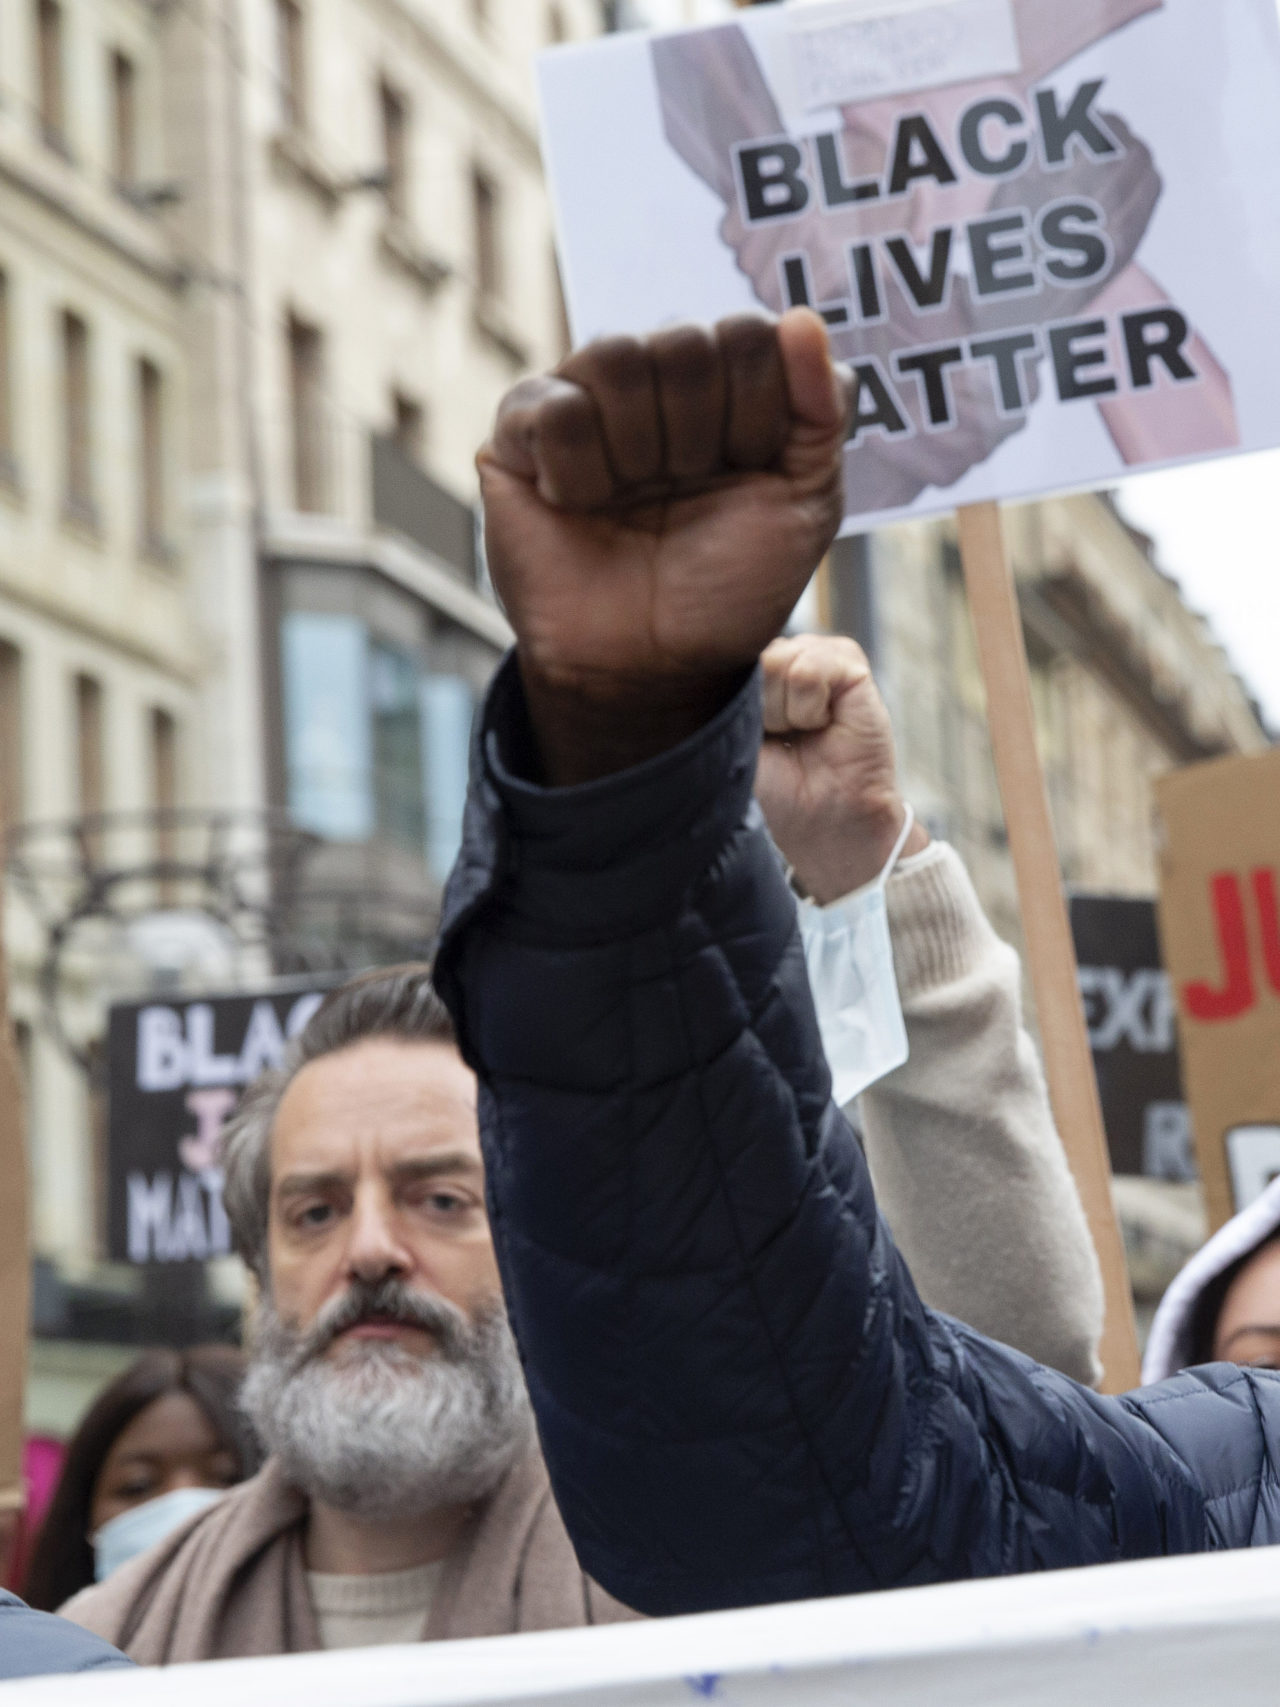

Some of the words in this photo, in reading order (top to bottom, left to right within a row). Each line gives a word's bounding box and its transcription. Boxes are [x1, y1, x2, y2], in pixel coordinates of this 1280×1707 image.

[737, 77, 1117, 222] BLACK
[783, 203, 1107, 326] LIVES
[848, 308, 1197, 441] ATTER
